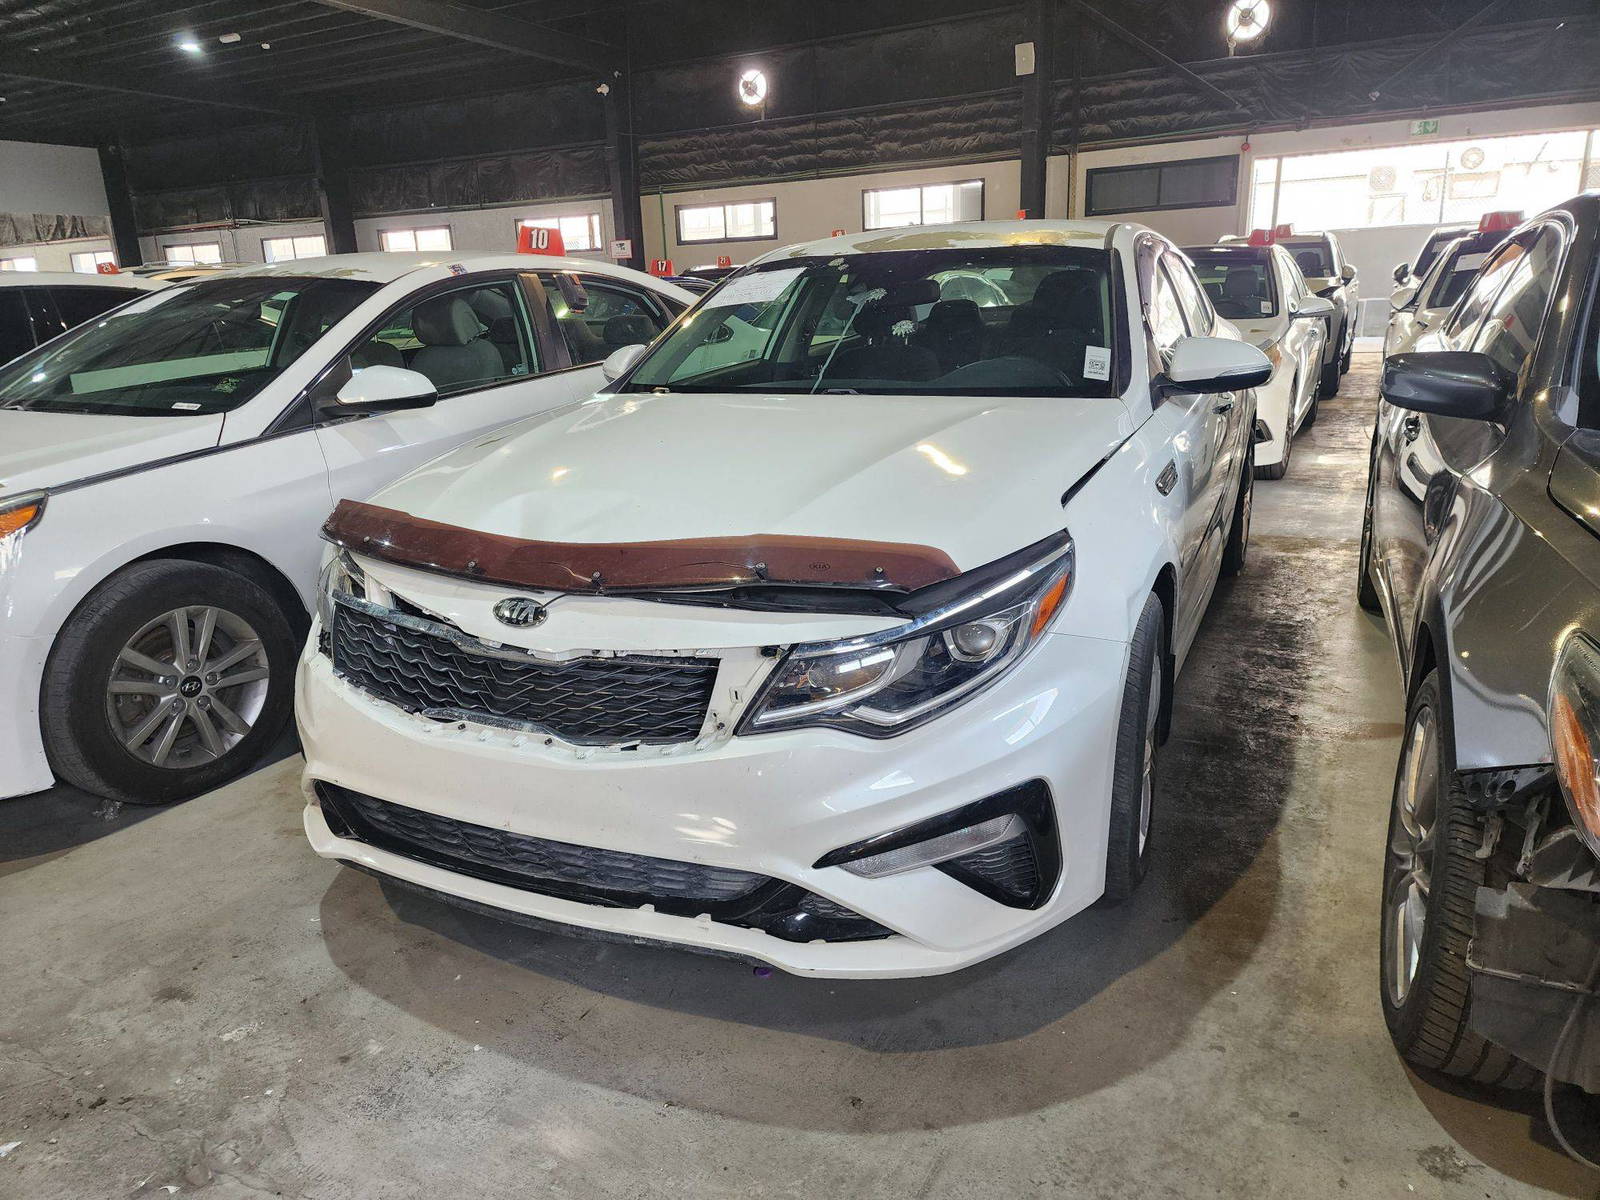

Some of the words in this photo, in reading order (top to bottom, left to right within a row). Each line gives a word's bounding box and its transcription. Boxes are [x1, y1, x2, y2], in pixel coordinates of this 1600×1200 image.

[531, 228, 549, 249] 10
[657, 260, 667, 272] 17
[498, 599, 536, 623] KIA
